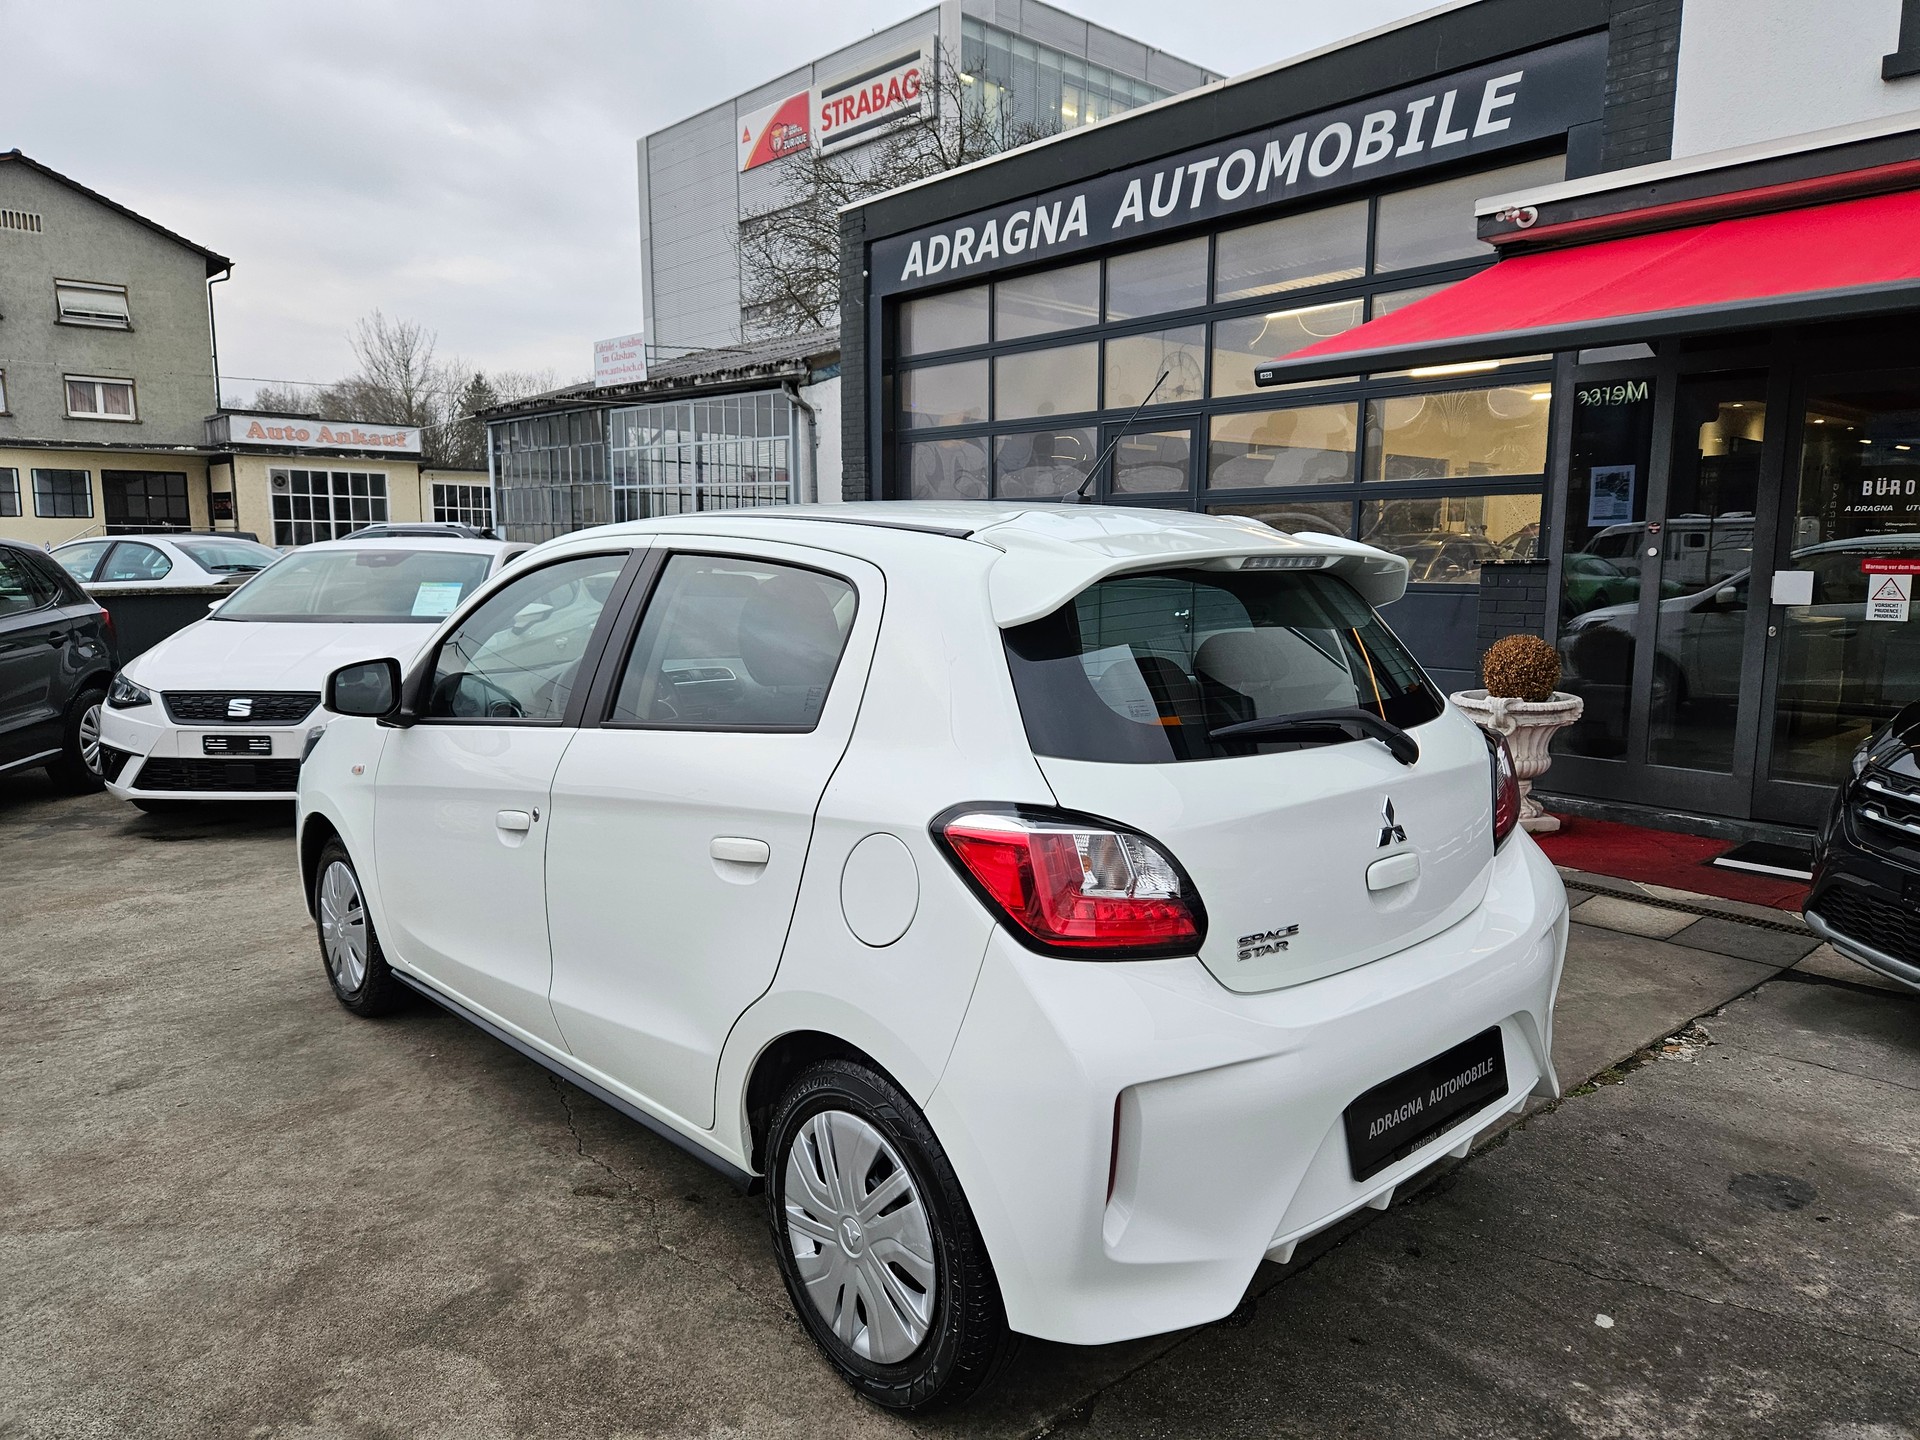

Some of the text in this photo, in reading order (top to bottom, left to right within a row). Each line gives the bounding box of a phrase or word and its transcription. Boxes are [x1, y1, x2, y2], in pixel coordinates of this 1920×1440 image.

[821, 68, 921, 131] STRABAG
[901, 71, 1524, 281] ADRAGNA AUTOMOBILE
[246, 421, 407, 448] Auto Ankauf
[1862, 477, 1916, 496] BÜRO
[1865, 563, 1888, 571] Warnung
[1237, 924, 1299, 948] SPACE
[1237, 940, 1289, 962] STAR
[1368, 1057, 1494, 1140] ADRAGNA AUTOMOBILE
